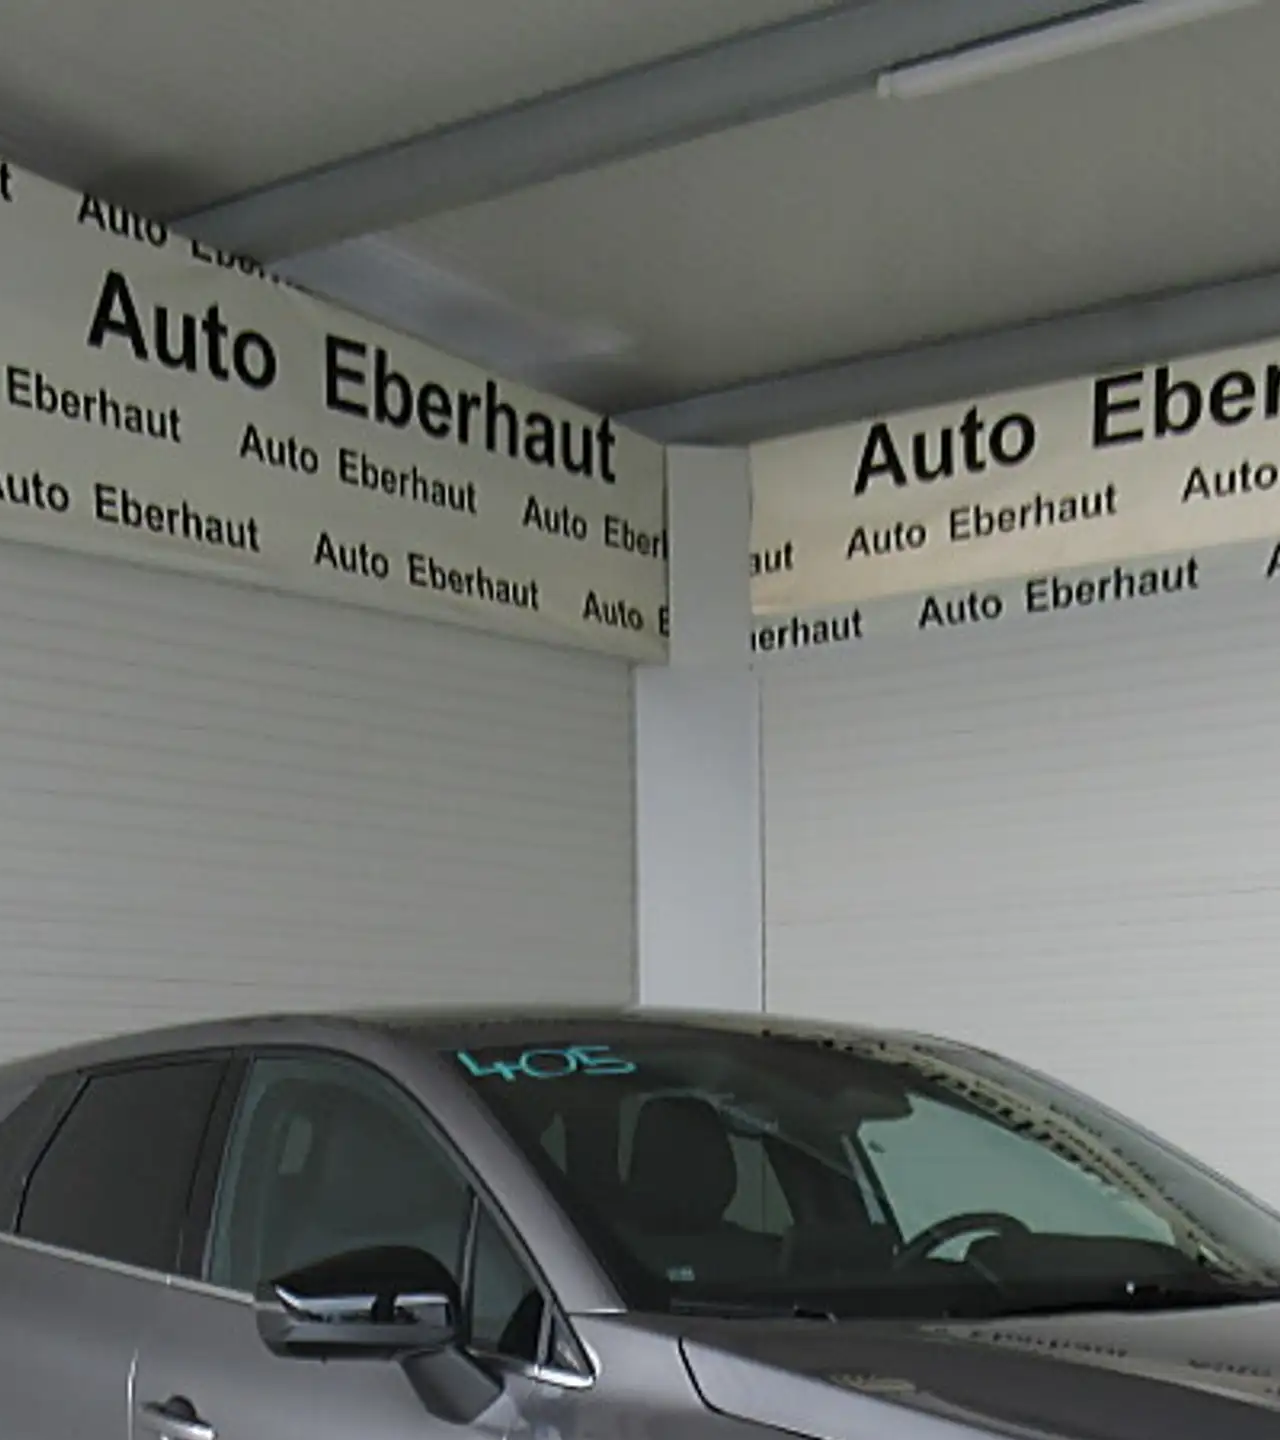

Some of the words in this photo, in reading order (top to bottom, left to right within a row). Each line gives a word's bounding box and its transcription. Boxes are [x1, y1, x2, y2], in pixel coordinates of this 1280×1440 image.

[78, 192, 169, 247] Auto
[6, 364, 182, 444] Eberhaut
[87, 268, 277, 391] Auto
[325, 333, 617, 484] Eberhaut
[239, 422, 319, 476] Auto
[338, 447, 478, 515] Eberhaut
[854, 406, 1036, 497] Auto
[1182, 460, 1279, 503] Auto
[94, 482, 261, 553] Eberhaut
[523, 494, 588, 541] Auto
[846, 521, 927, 562] Auto
[949, 483, 1119, 542] Eberhaut
[314, 531, 390, 581] Auto
[407, 551, 540, 612] Eberhaut
[918, 590, 1004, 630] Auto
[1025, 555, 1200, 614] Eberhaut
[582, 589, 646, 632] Auto
[457, 1045, 637, 1082] 405
